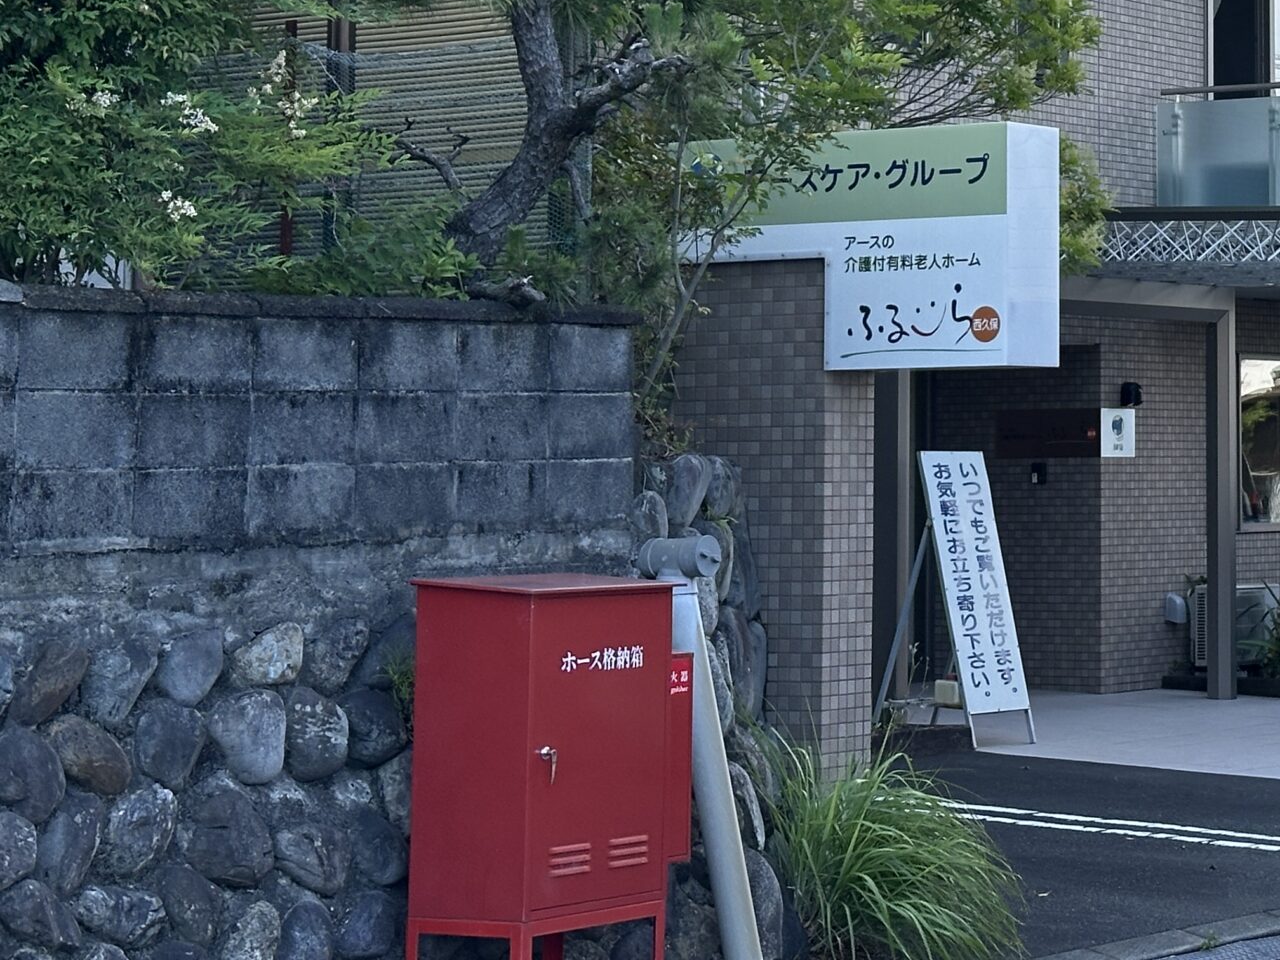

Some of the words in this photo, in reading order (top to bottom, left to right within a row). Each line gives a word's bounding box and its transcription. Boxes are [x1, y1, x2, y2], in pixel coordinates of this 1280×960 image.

[844, 234, 895, 251] アースの
[844, 252, 982, 274] 介護付有料老人ホーム
[972, 317, 999, 332] 西久保
[932, 463, 991, 697] お気軽にお立ち寄り下さい。
[959, 463, 1018, 693] いつでもご覧いただけます。
[560, 645, 644, 673] ホース格納箱
